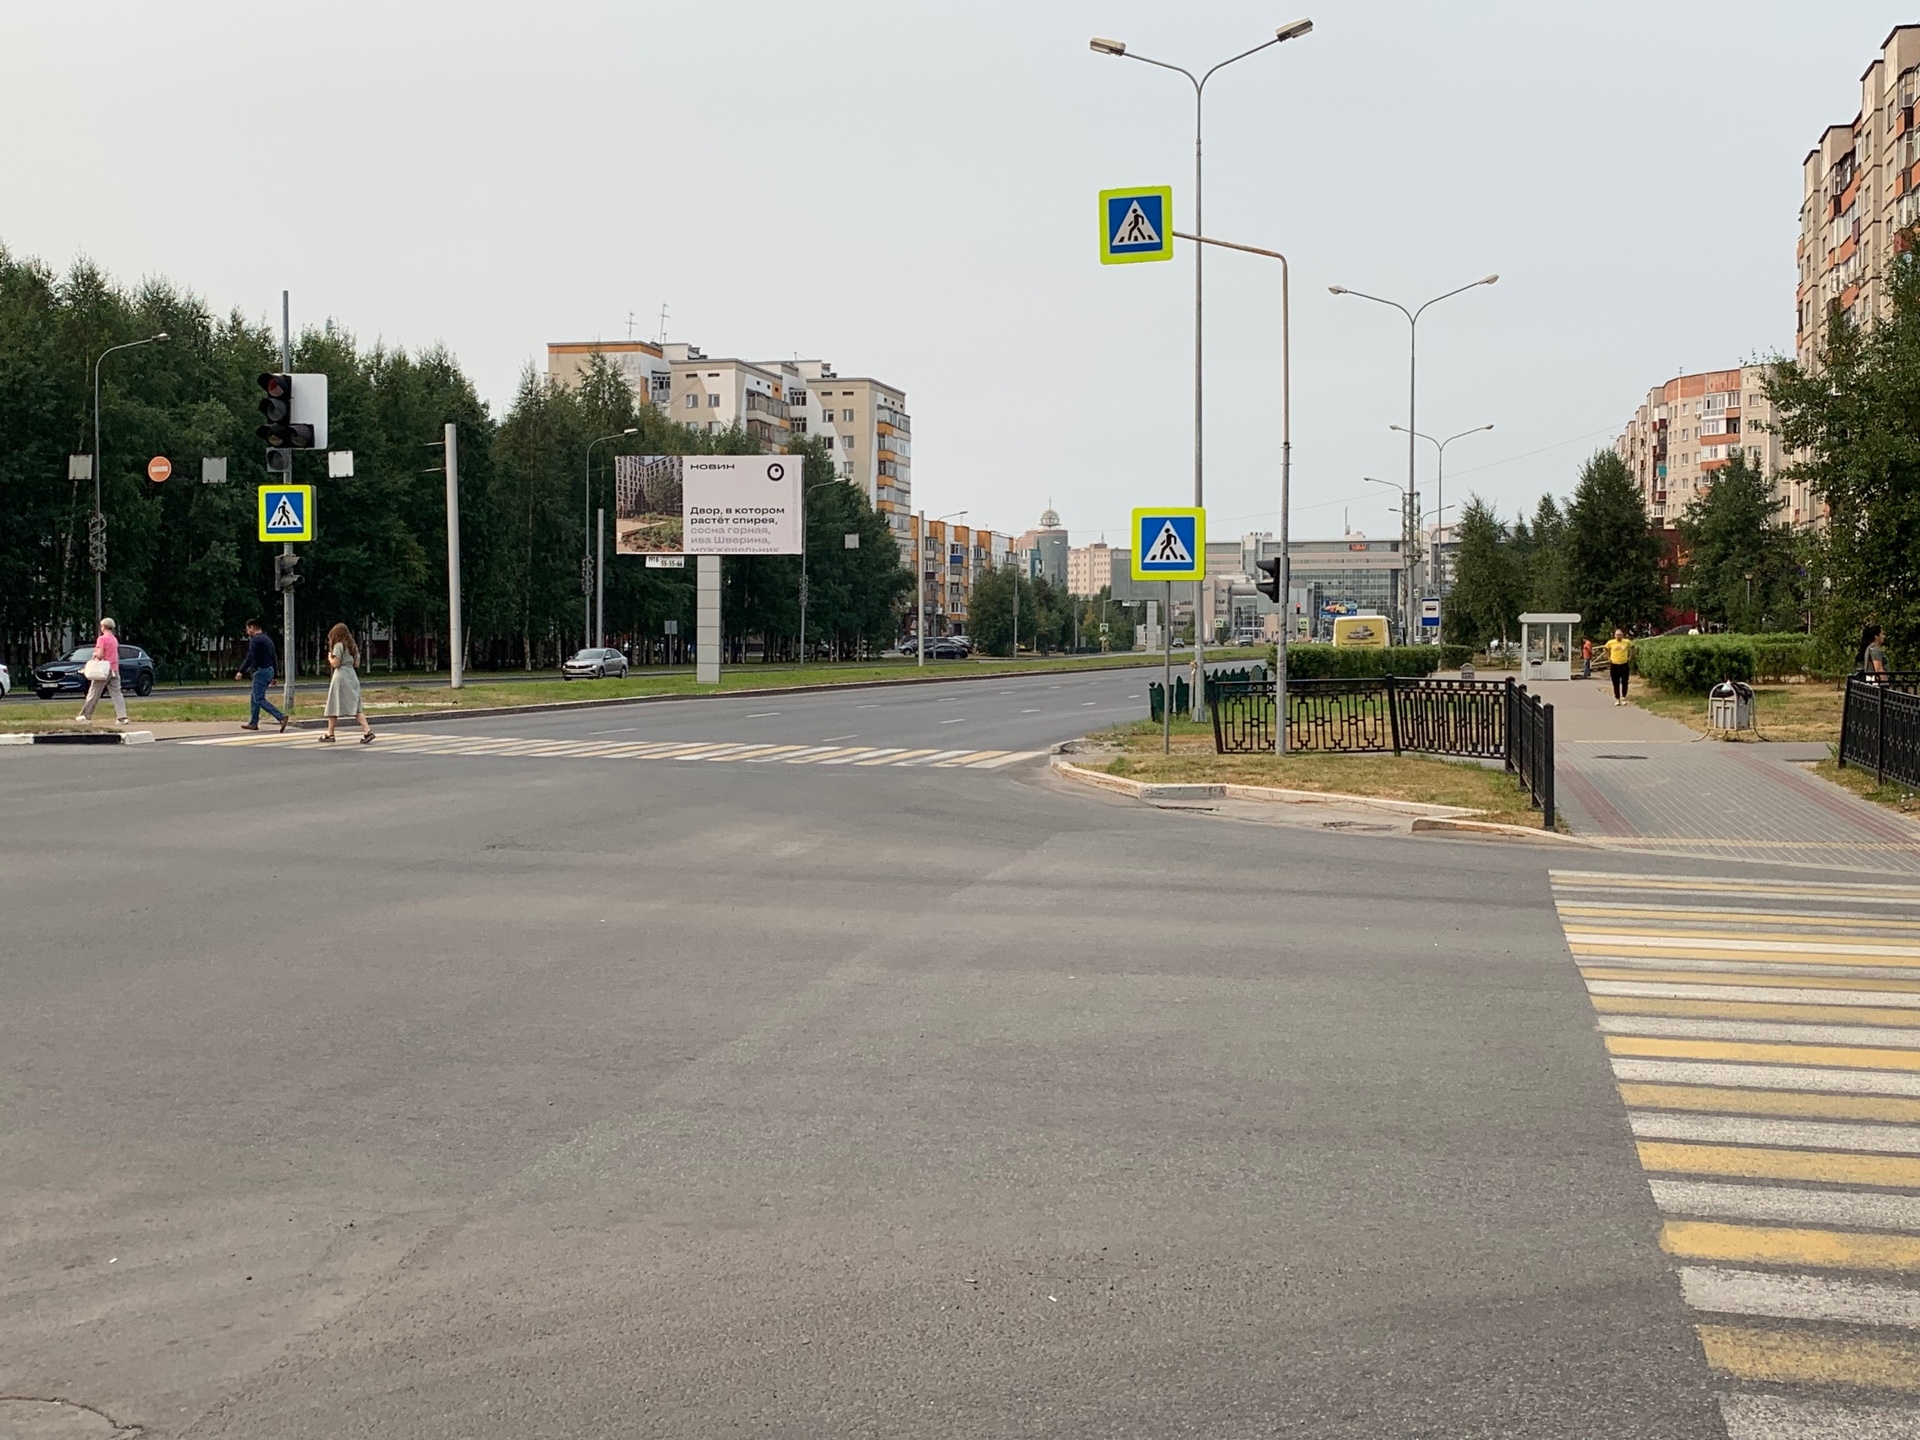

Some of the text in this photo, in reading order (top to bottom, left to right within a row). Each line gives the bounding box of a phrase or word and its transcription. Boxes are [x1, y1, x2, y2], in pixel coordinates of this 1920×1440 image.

[690, 506, 723, 516] Двор,
[734, 507, 785, 515] котором
[690, 516, 778, 526] растёт спирея,
[727, 527, 771, 535] горная,
[714, 536, 771, 546] Шверина,
